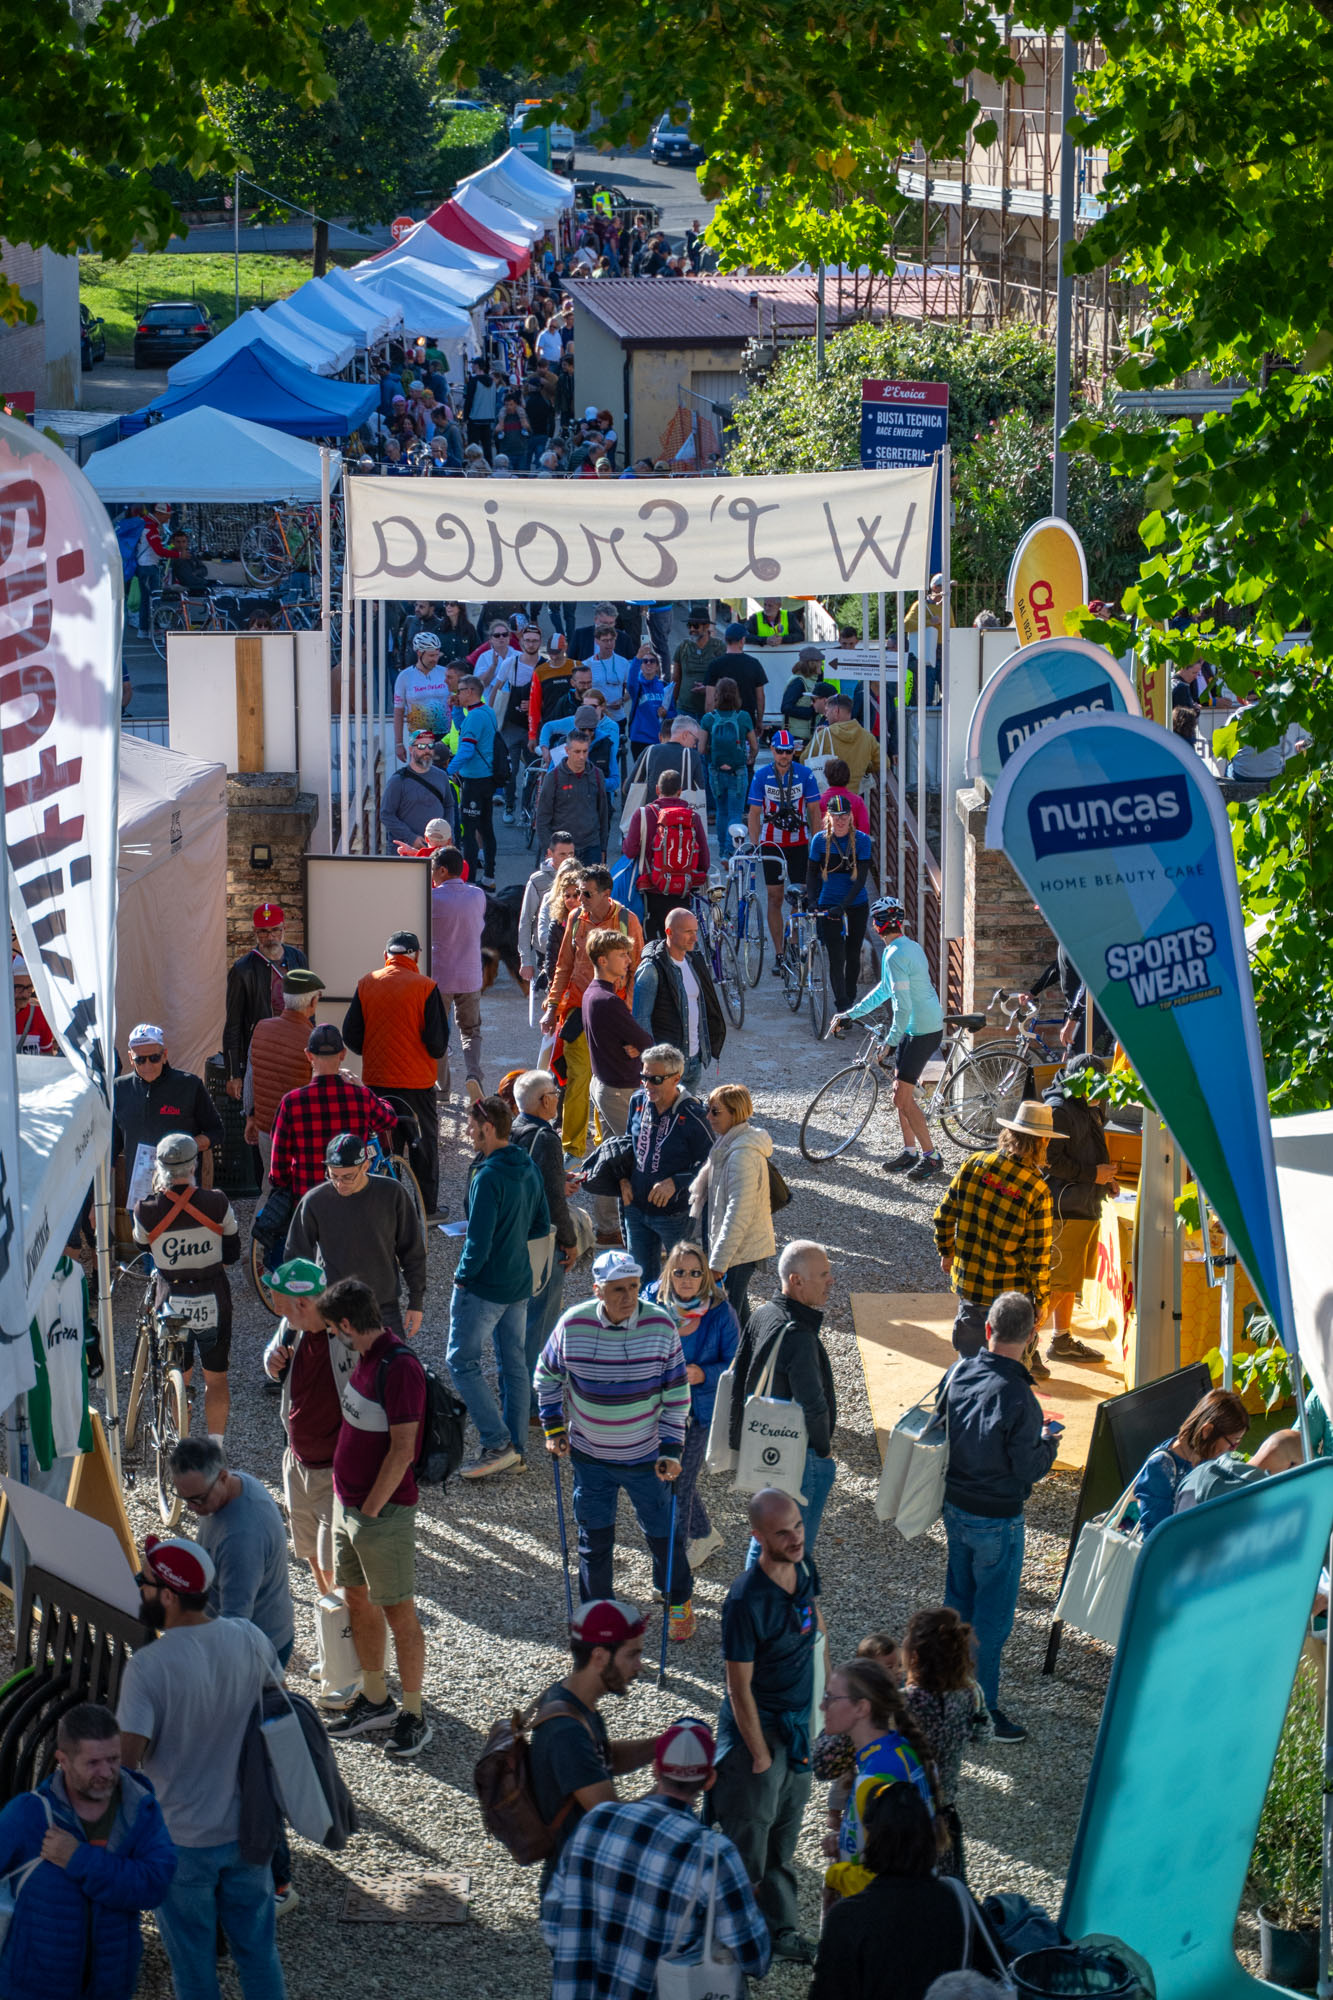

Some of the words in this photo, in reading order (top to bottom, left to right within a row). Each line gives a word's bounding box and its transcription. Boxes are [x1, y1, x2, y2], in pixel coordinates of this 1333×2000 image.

[882, 385, 927, 399] L'Eroica
[877, 411, 905, 425] BUSTA
[906, 413, 943, 428] TECNICA
[875, 426, 893, 436] RACE
[892, 427, 924, 438] ENVELOPE
[875, 446, 927, 462] SEGRETERIA
[1018, 598, 1029, 620] DAL
[1024, 619, 1033, 641] 1923
[1039, 790, 1180, 833] nuncas
[1077, 825, 1152, 841] MILANO
[1041, 876, 1087, 892] HOME
[1095, 869, 1156, 887] BEAUTY
[1164, 863, 1205, 880] CARE
[1107, 924, 1214, 980] SPORTS
[1129, 958, 1209, 1006] WEAR
[161, 1237, 214, 1266] Gino
[180, 1307, 208, 1323] 4745
[747, 1420, 799, 1440] L'Eroica
